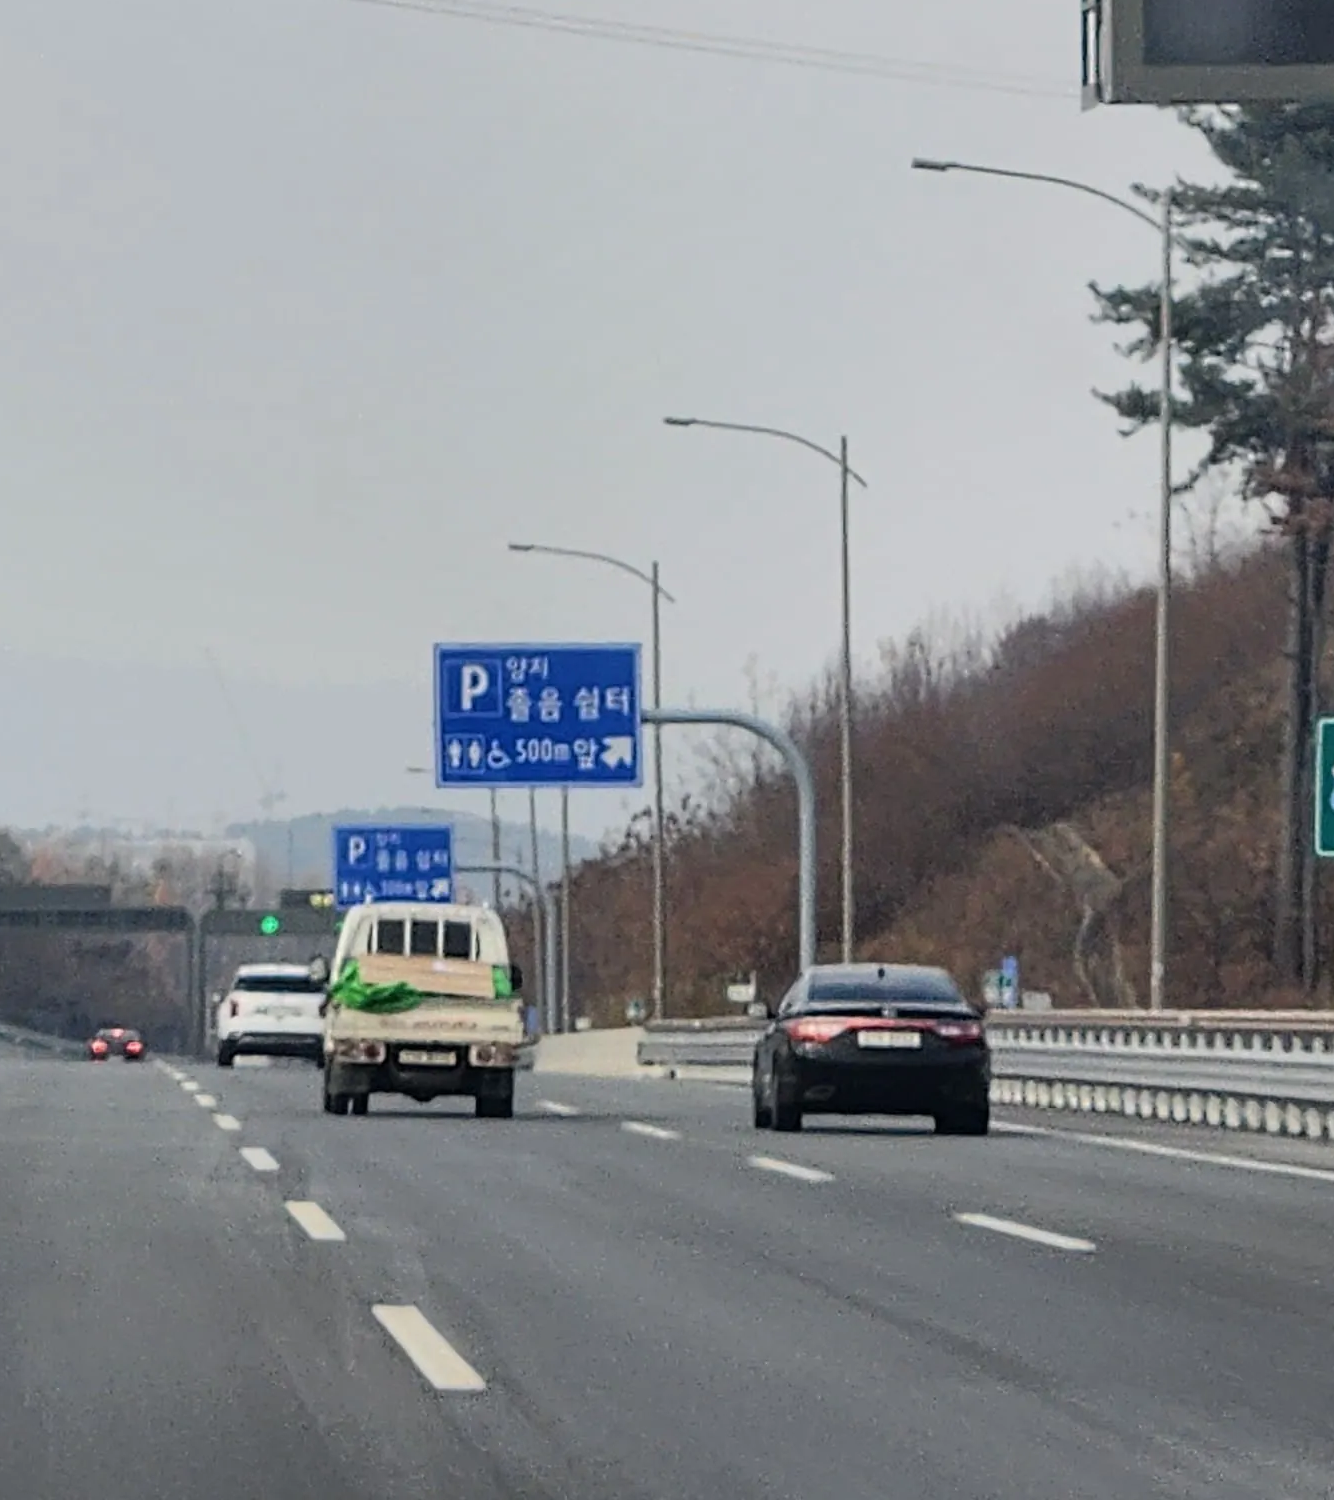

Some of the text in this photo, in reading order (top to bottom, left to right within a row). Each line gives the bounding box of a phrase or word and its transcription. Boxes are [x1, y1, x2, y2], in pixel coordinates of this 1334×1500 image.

[461, 664, 489, 711] P
[516, 738, 598, 770] 500m 앞
[348, 835, 366, 866] P
